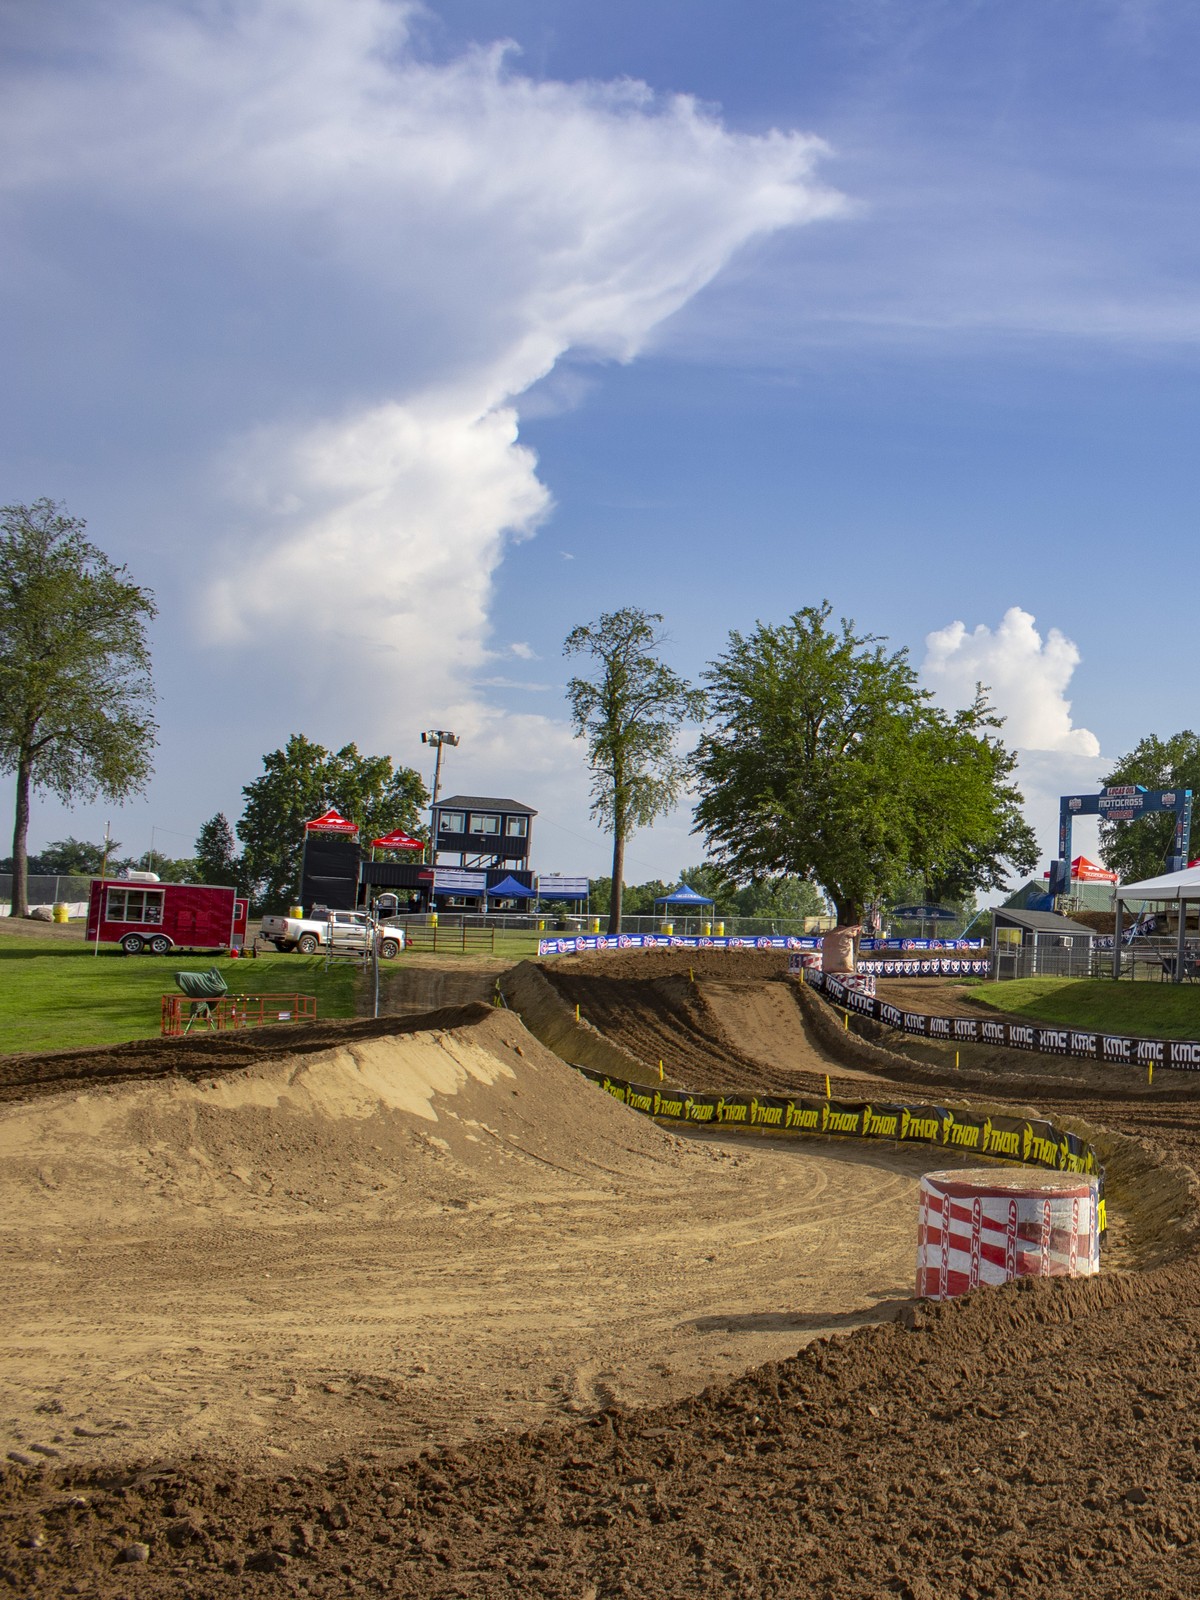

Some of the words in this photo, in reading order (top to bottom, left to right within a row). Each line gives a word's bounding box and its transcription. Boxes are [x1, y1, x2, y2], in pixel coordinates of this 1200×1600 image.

[1098, 798, 1143, 808] MOTOCROSS
[847, 990, 874, 1012] KMC
[880, 1003, 901, 1025] KMC
[904, 1013, 925, 1030] KMC
[930, 1017, 950, 1033] KMC
[954, 1020, 977, 1036] KMC
[982, 1022, 1004, 1039] KMC
[1009, 1025, 1033, 1044] KMC
[1071, 1033, 1096, 1052] KMC
[1103, 1037, 1131, 1057] KMC
[1137, 1041, 1163, 1060] KMC
[1171, 1043, 1200, 1063] KMC
[1171, 1062, 1200, 1070] WHEELS
[630, 1093, 652, 1111] THOR
[660, 1100, 682, 1117] THOR
[691, 1104, 714, 1120] THOR
[723, 1105, 747, 1121] THOR
[758, 1106, 783, 1124] THOR
[792, 1109, 818, 1128] THOR
[828, 1112, 859, 1131] THOR
[870, 1115, 897, 1135] THOR
[910, 1118, 939, 1139] THOR
[951, 1123, 979, 1147] THOR
[991, 1129, 1020, 1155] THOR
[1033, 1137, 1058, 1167] THOR
